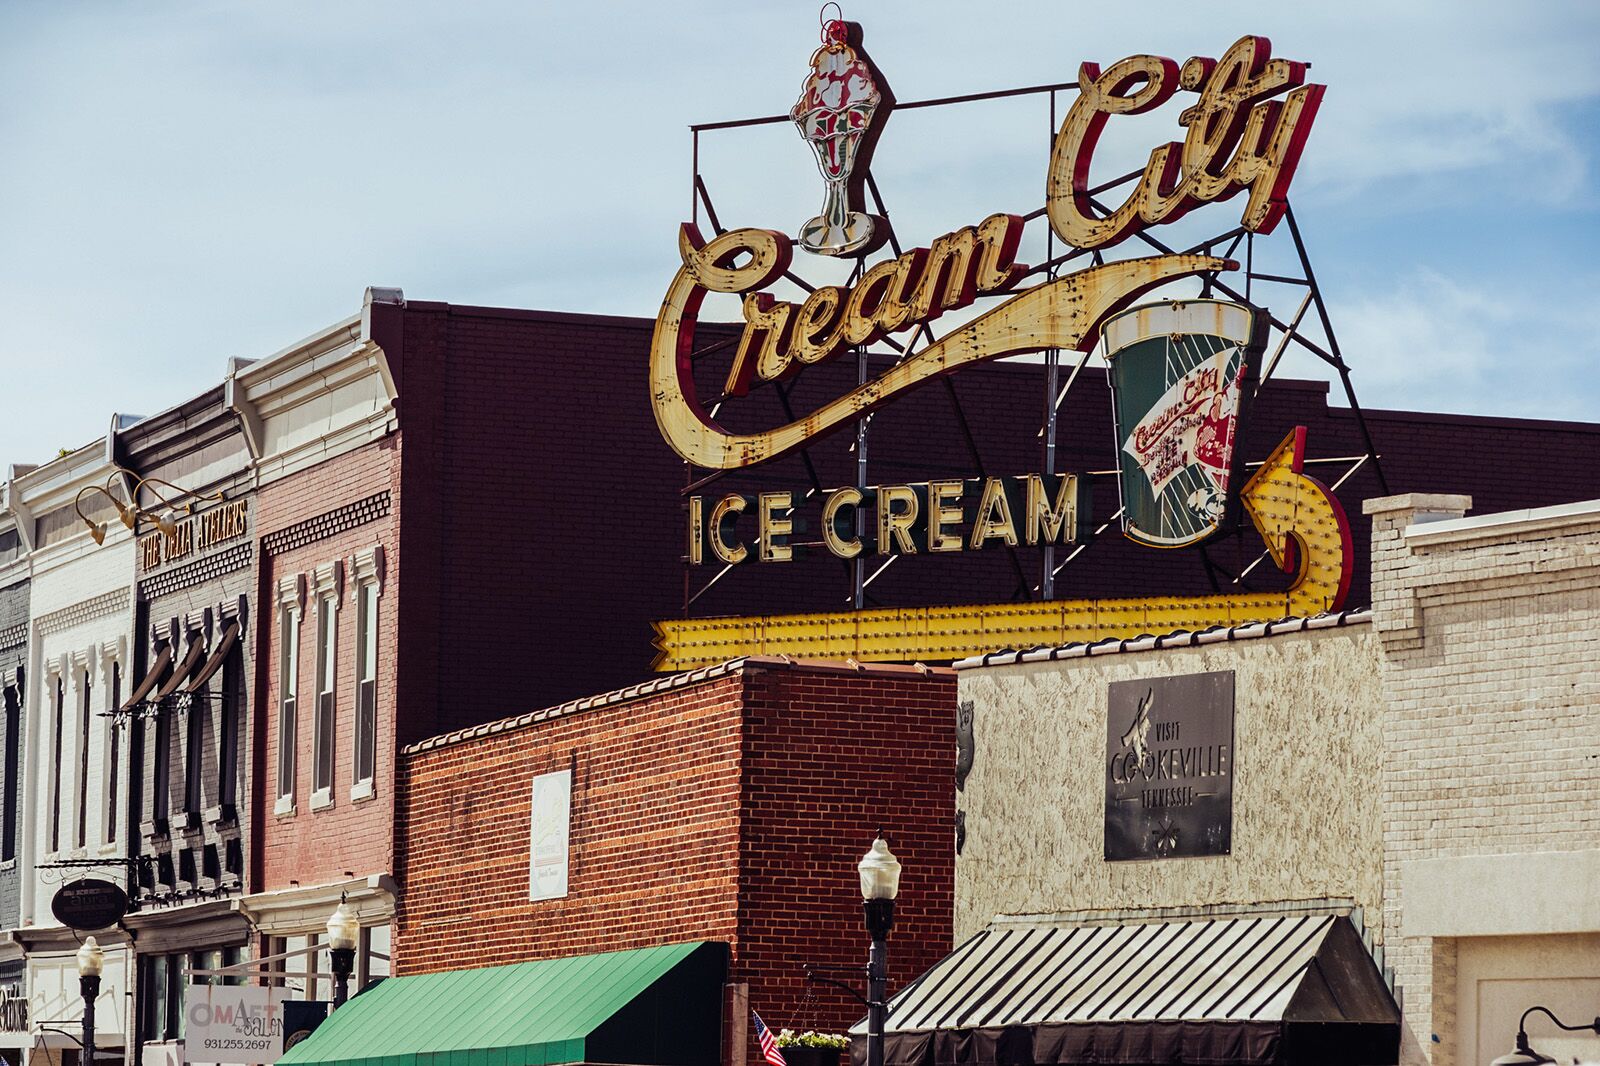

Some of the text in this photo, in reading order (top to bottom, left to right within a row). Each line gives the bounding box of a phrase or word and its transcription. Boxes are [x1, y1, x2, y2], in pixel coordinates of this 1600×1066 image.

[1046, 35, 1324, 248] City
[649, 213, 1028, 469] Cream
[141, 534, 161, 571] THE
[198, 500, 247, 547] ATELIERS
[688, 472, 1079, 566] ICE CREAM
[1156, 722, 1180, 742] VISIT
[1111, 745, 1227, 784] COOKEVILLE
[1141, 785, 1194, 809] TENNESSEE
[204, 1039, 271, 1050] 931.255.2697
